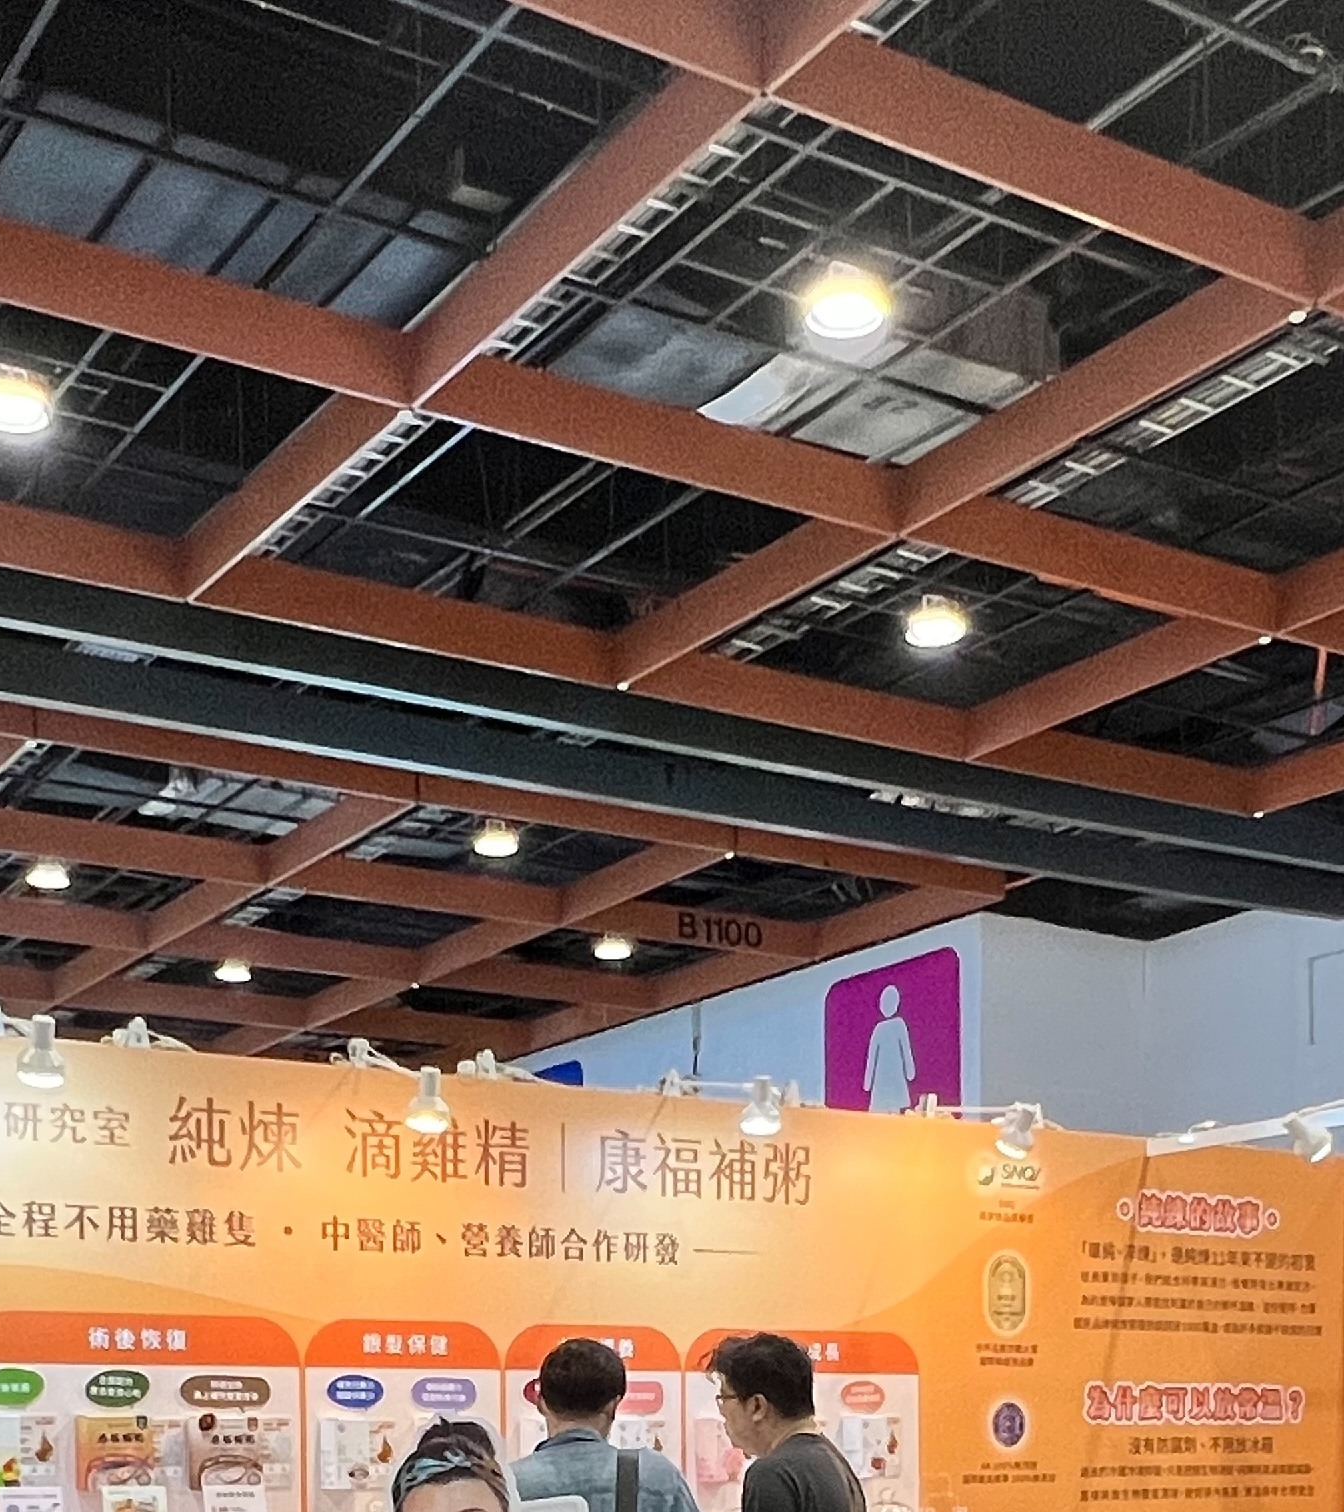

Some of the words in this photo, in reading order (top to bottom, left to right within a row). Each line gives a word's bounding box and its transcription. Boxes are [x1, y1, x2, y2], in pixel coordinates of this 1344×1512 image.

[678, 911, 763, 948] B1100
[167, 1095, 303, 1173] 純煉
[343, 1106, 531, 1189] 滴雞精
[594, 1128, 812, 1206] 康福補粥
[321, 1214, 680, 1266] 中醫師、營養師合作研發
